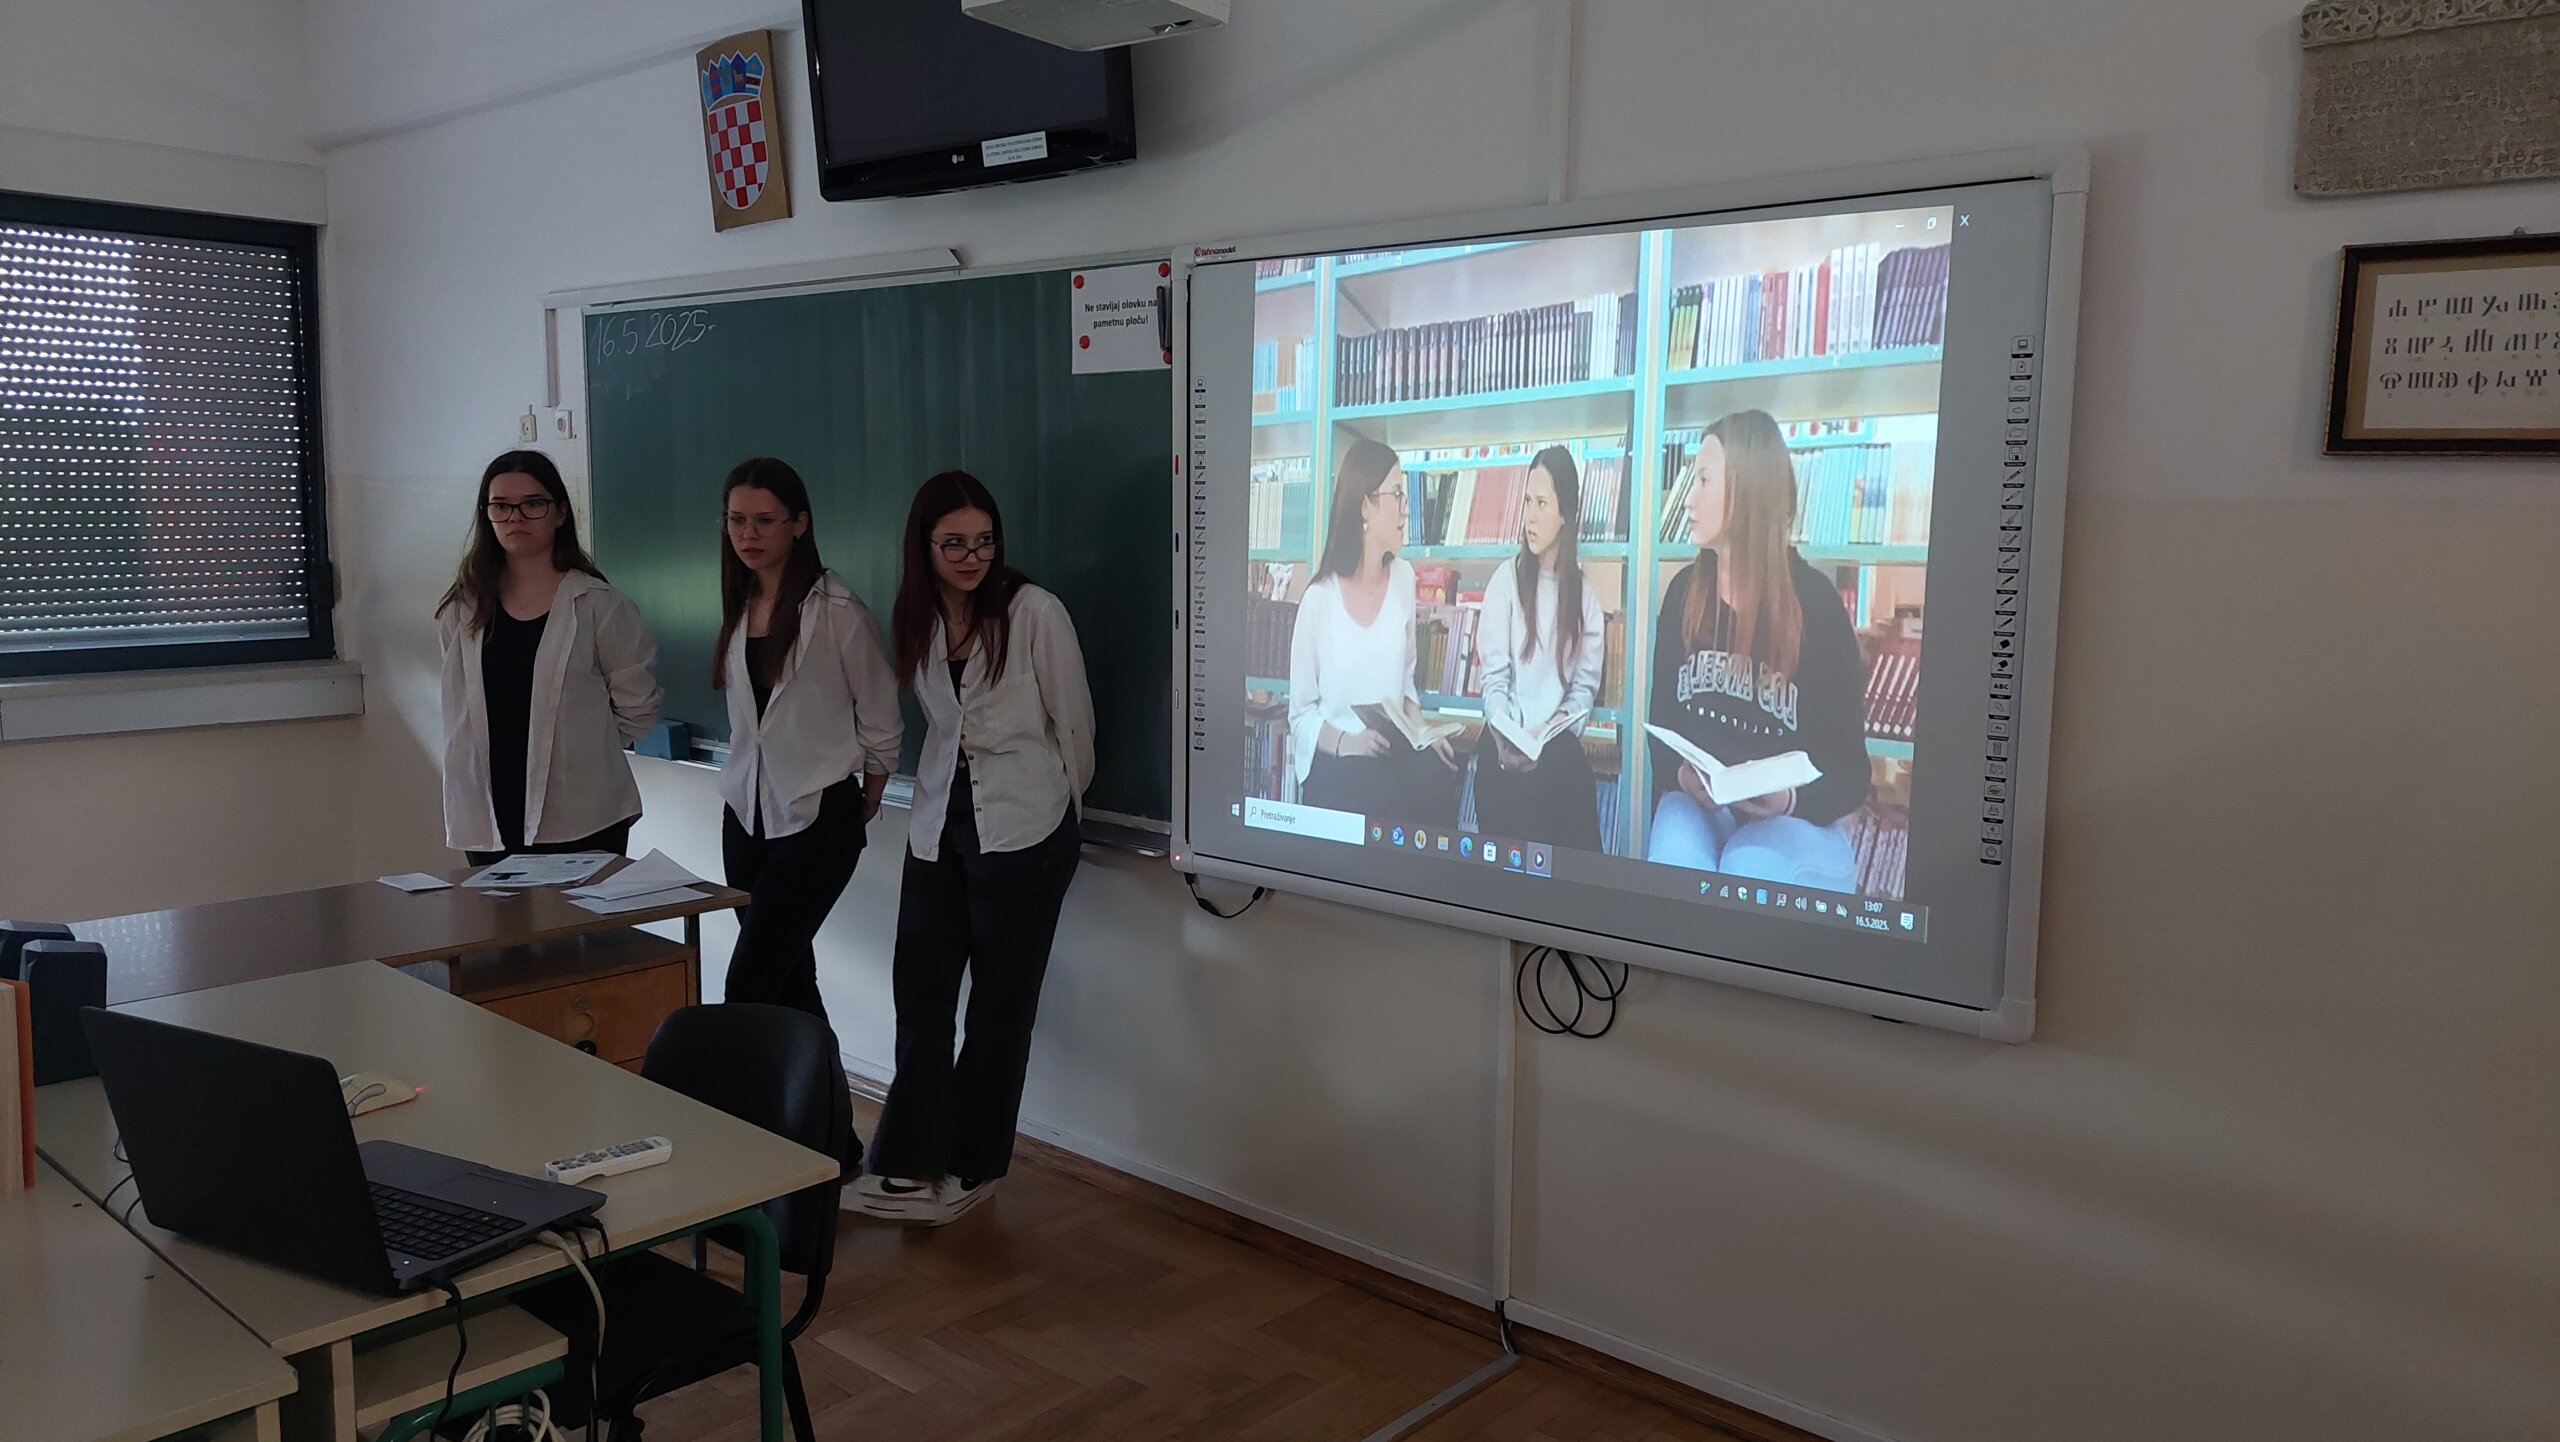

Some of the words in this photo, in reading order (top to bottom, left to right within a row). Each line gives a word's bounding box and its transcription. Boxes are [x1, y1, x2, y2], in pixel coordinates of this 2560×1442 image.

[1084, 303, 1095, 313] Ne
[1096, 300, 1120, 312] stavljaj
[1121, 298, 1146, 309] olovku
[1148, 299, 1158, 307] na
[1093, 318, 1125, 330] pametnu
[1126, 314, 1149, 327] ploču!
[1260, 809, 1296, 825] Pretraživanje
[1864, 900, 1883, 913] 13:07
[1855, 915, 1890, 931] 16.5.2025.
